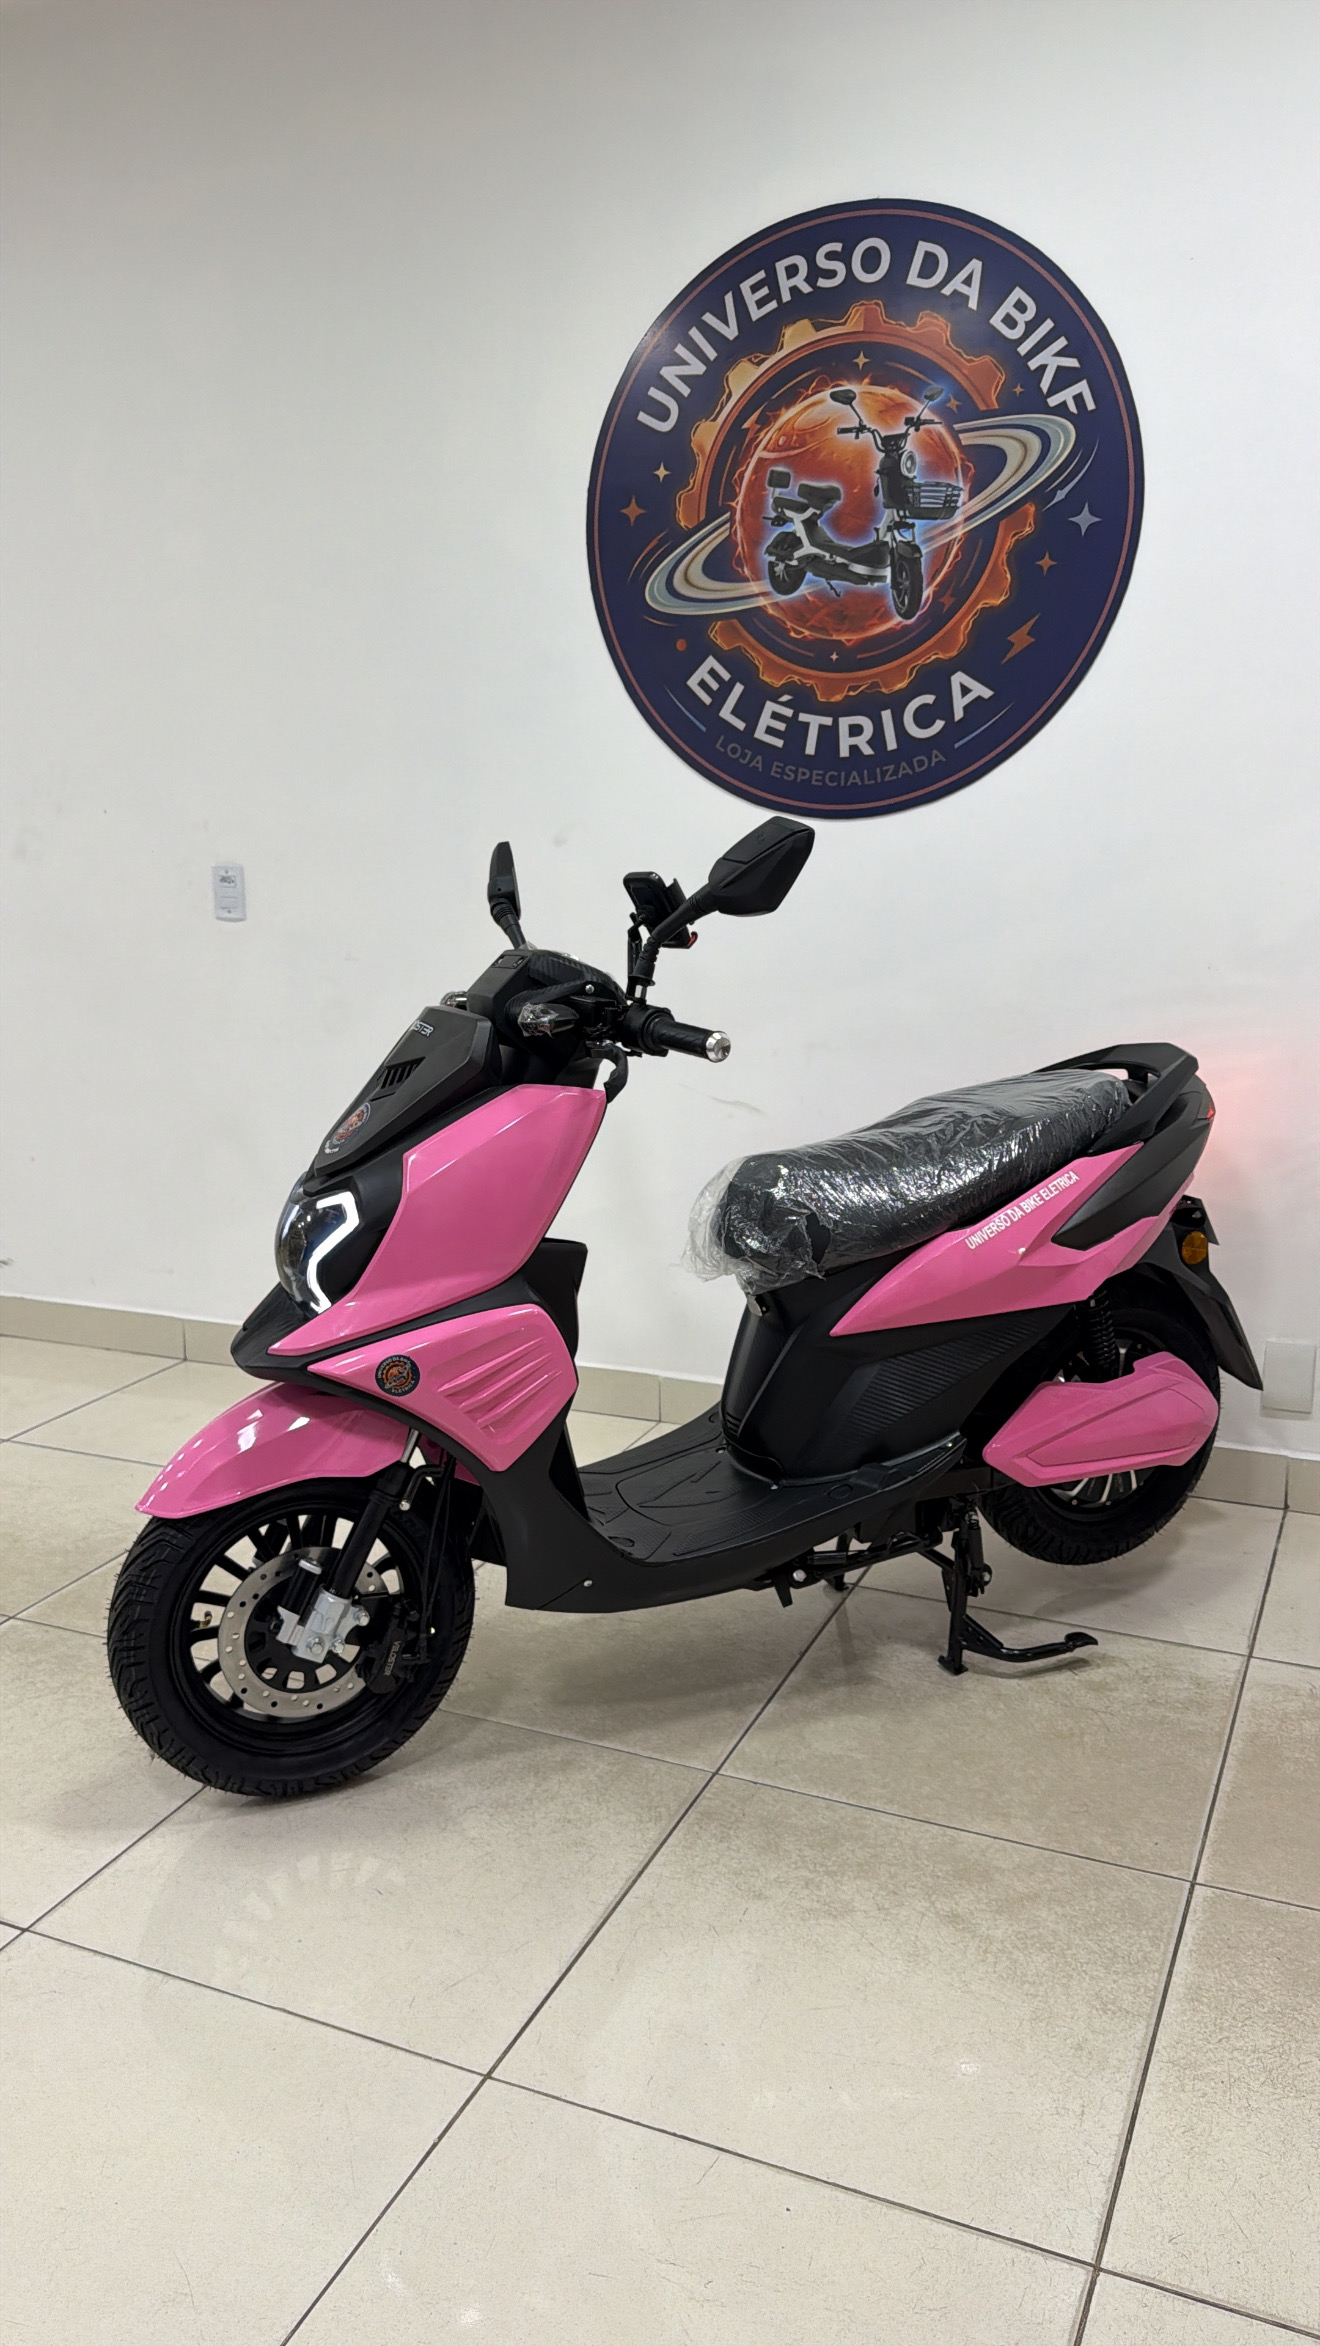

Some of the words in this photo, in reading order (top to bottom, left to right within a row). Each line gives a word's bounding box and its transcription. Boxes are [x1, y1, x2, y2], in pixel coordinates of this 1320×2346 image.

[637, 237, 892, 433] UNIVERSO
[906, 240, 984, 311] DA
[686, 655, 995, 759] ELÉTRICA
[715, 735, 764, 773] LOJA
[770, 749, 946, 787] ESPECIALIZADA
[965, 1214, 1011, 1249] UNIVERSO
[1007, 1206, 1026, 1222] DA
[1019, 1193, 1044, 1213] BIKE
[1039, 1171, 1079, 1200] ELETRICA
